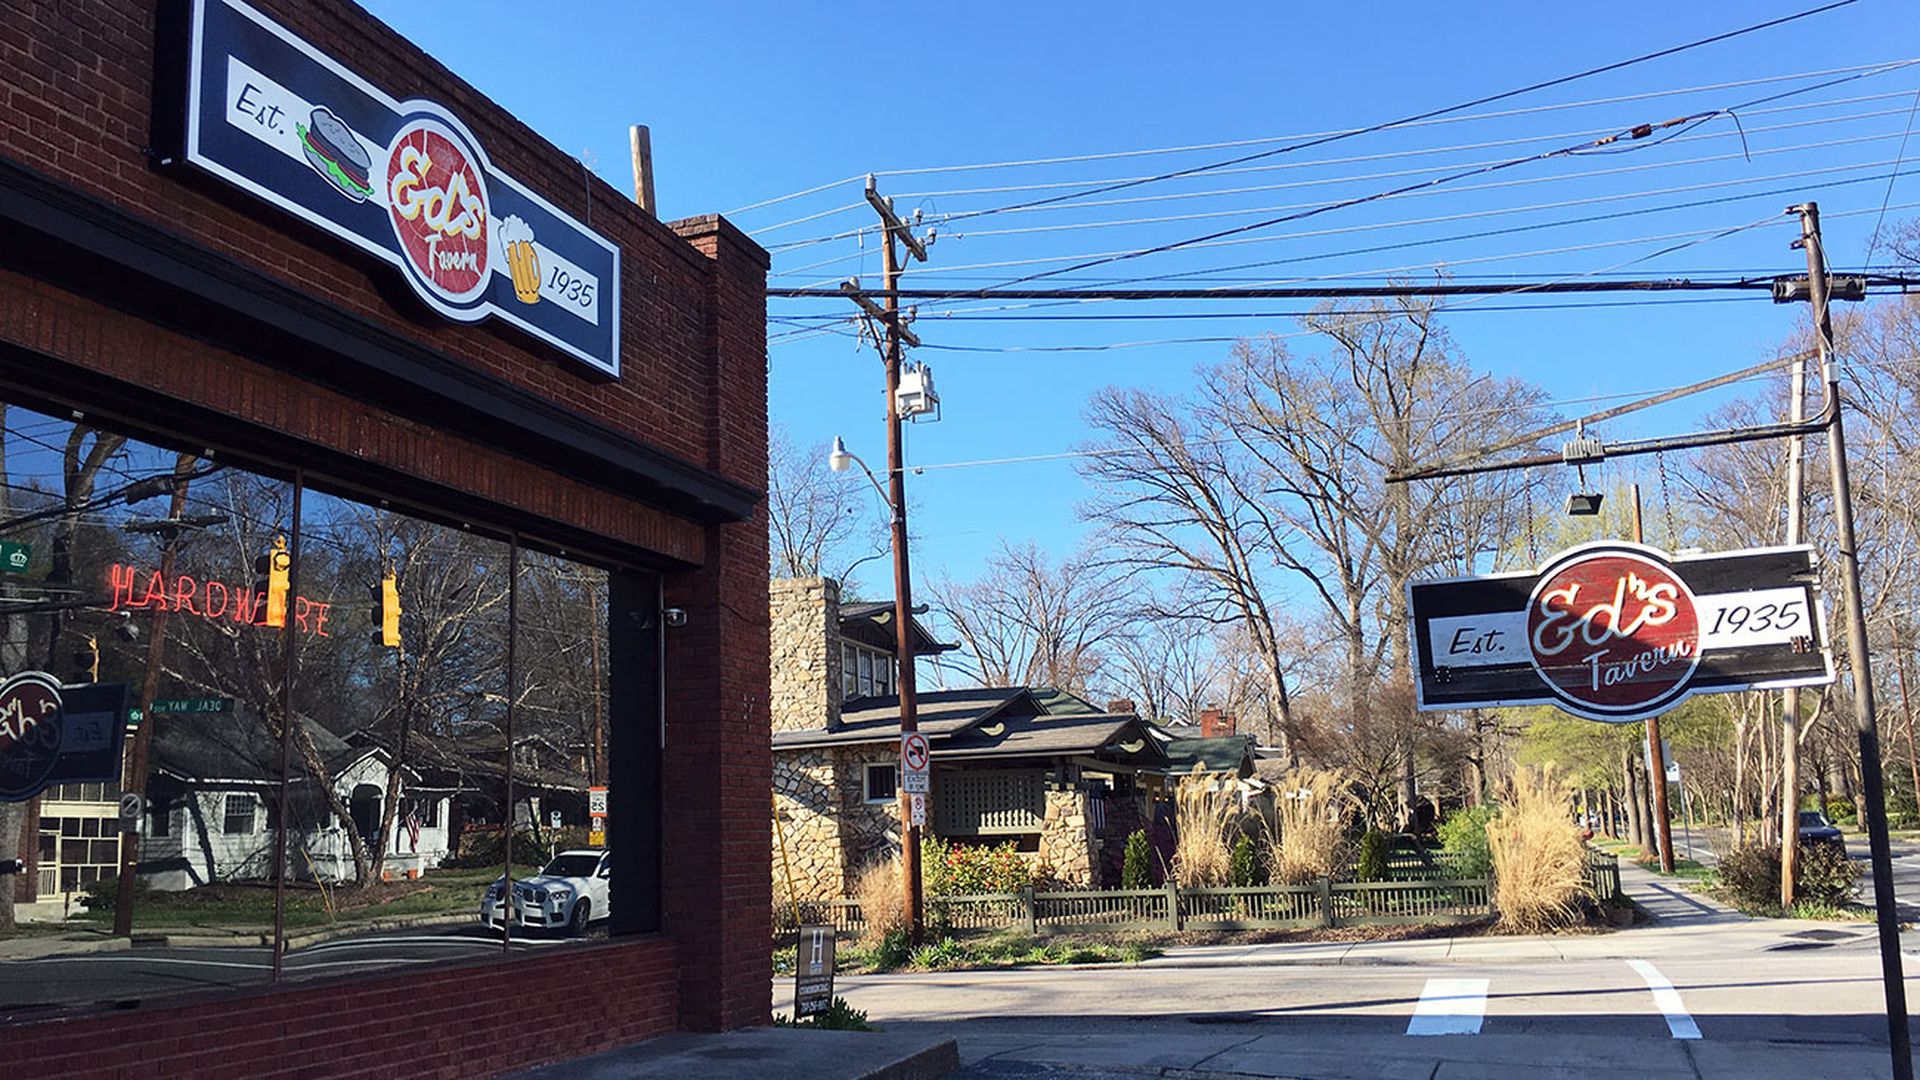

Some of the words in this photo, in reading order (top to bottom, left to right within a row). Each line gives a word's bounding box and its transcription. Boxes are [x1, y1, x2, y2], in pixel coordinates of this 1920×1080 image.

[235, 83, 285, 136] Est.
[391, 145, 485, 240] Ed's
[424, 233, 479, 272] Tavern
[547, 266, 595, 308] 1935
[1533, 572, 1679, 656] Ed's
[1709, 601, 1803, 636] 1935
[1449, 627, 1506, 656] Est.
[1582, 638, 1692, 692] Tavern
